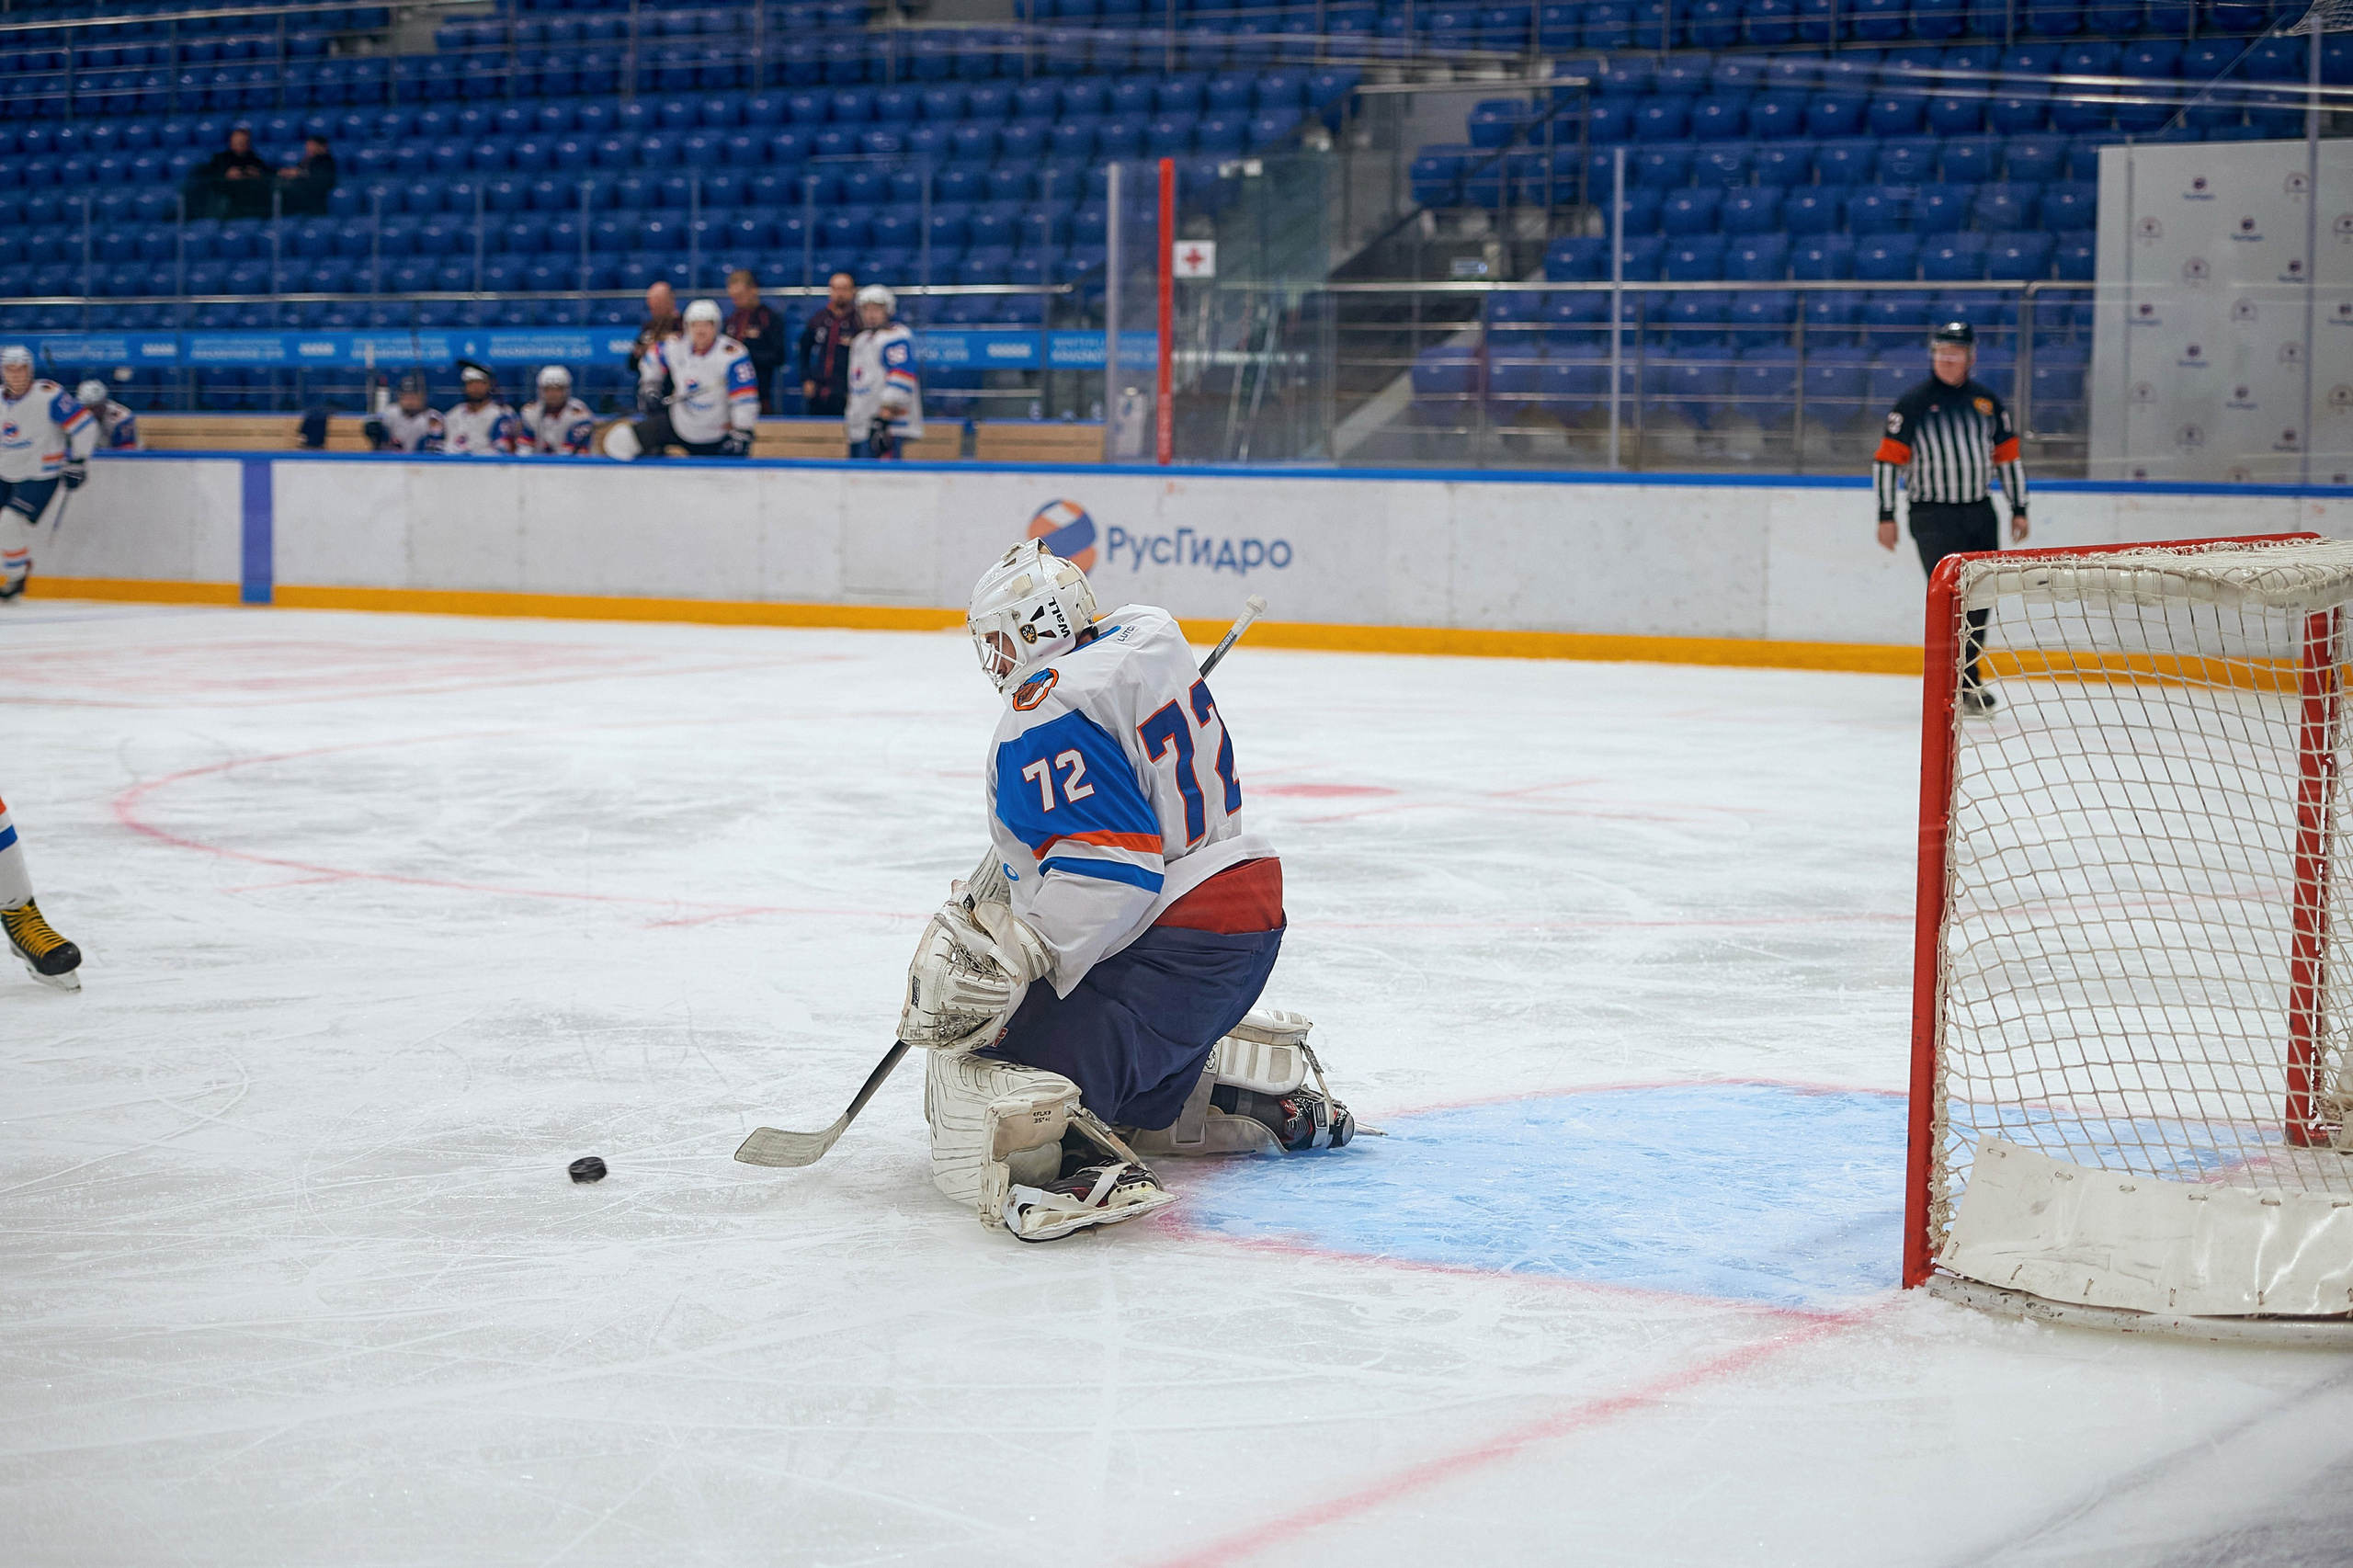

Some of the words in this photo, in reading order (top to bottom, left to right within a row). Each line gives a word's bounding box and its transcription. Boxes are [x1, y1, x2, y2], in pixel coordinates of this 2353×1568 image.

[1106, 526, 1293, 576] РусГидро
[1021, 747, 1096, 813] 72
[1136, 677, 1243, 847] 72
